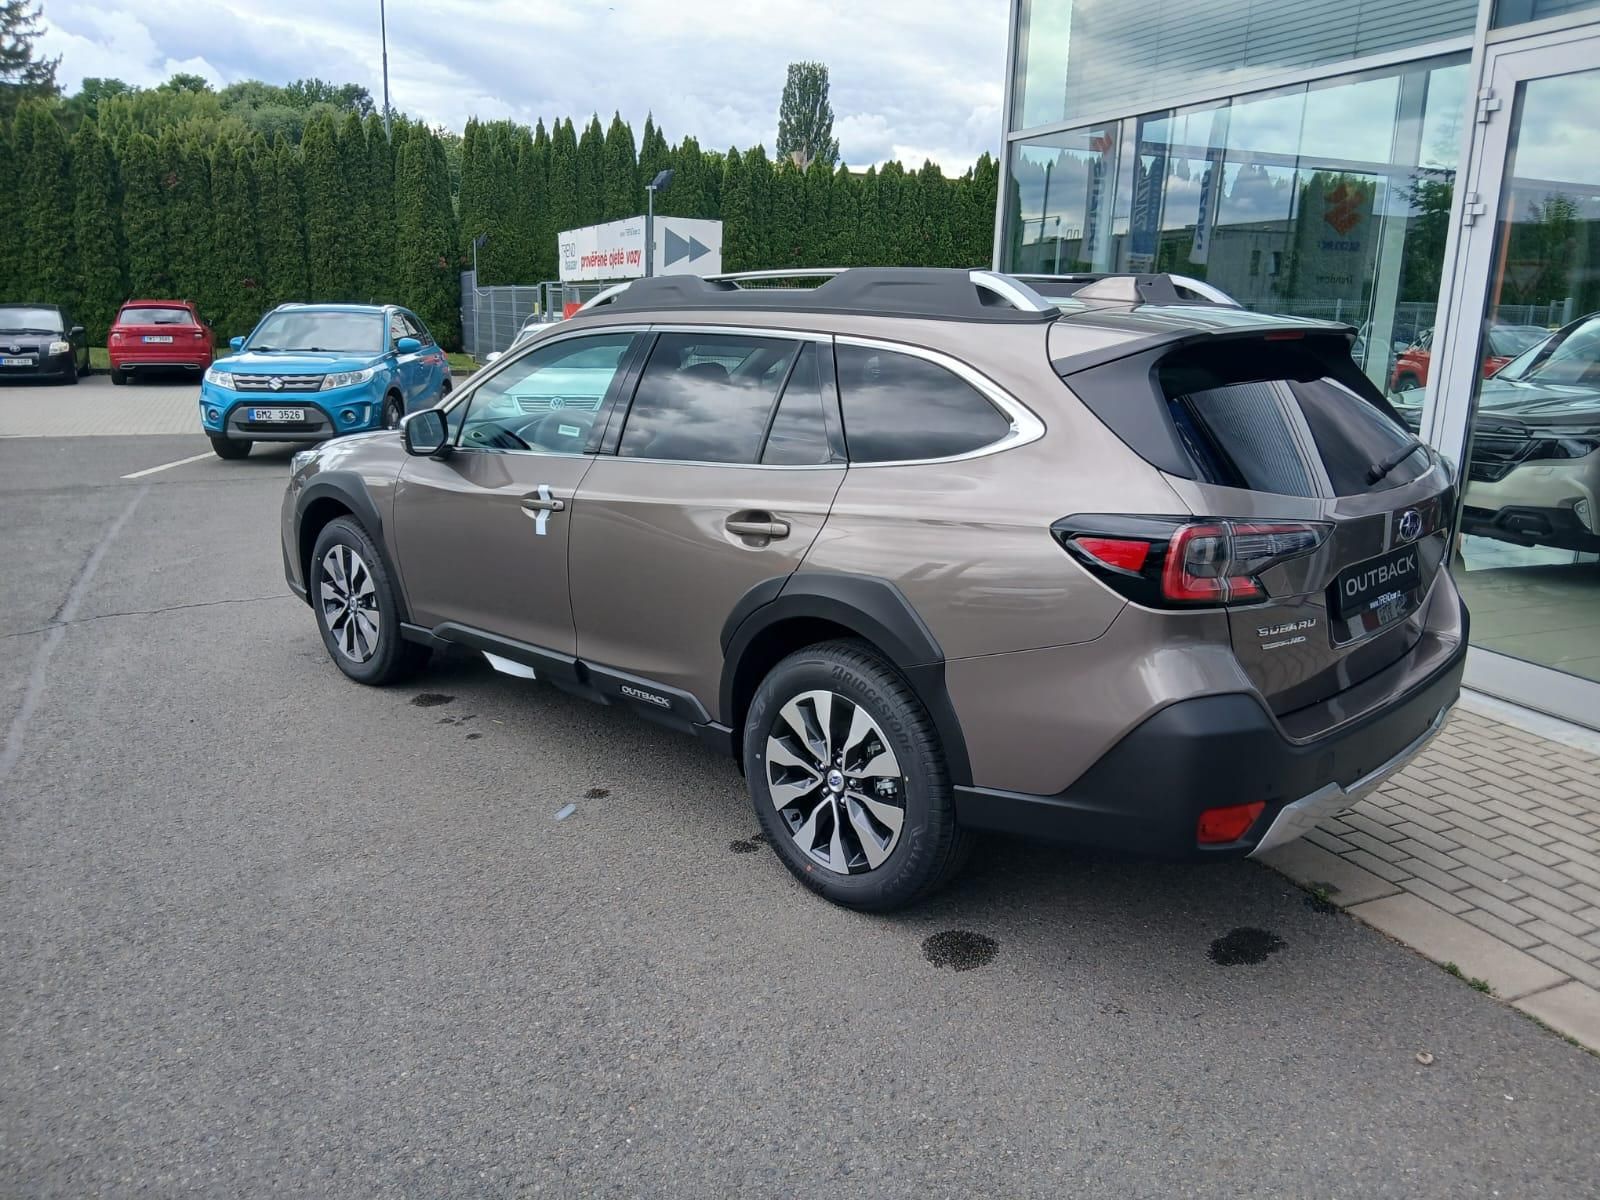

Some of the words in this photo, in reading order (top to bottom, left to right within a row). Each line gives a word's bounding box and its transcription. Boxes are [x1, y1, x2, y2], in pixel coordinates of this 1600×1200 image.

[626, 249, 641, 267] vozy
[256, 410, 272, 420] 6M2
[278, 410, 301, 420] 3526
[1345, 553, 1416, 597] OUTBACK
[1256, 618, 1317, 637] SUBARU
[621, 685, 670, 708] OUTBACK
